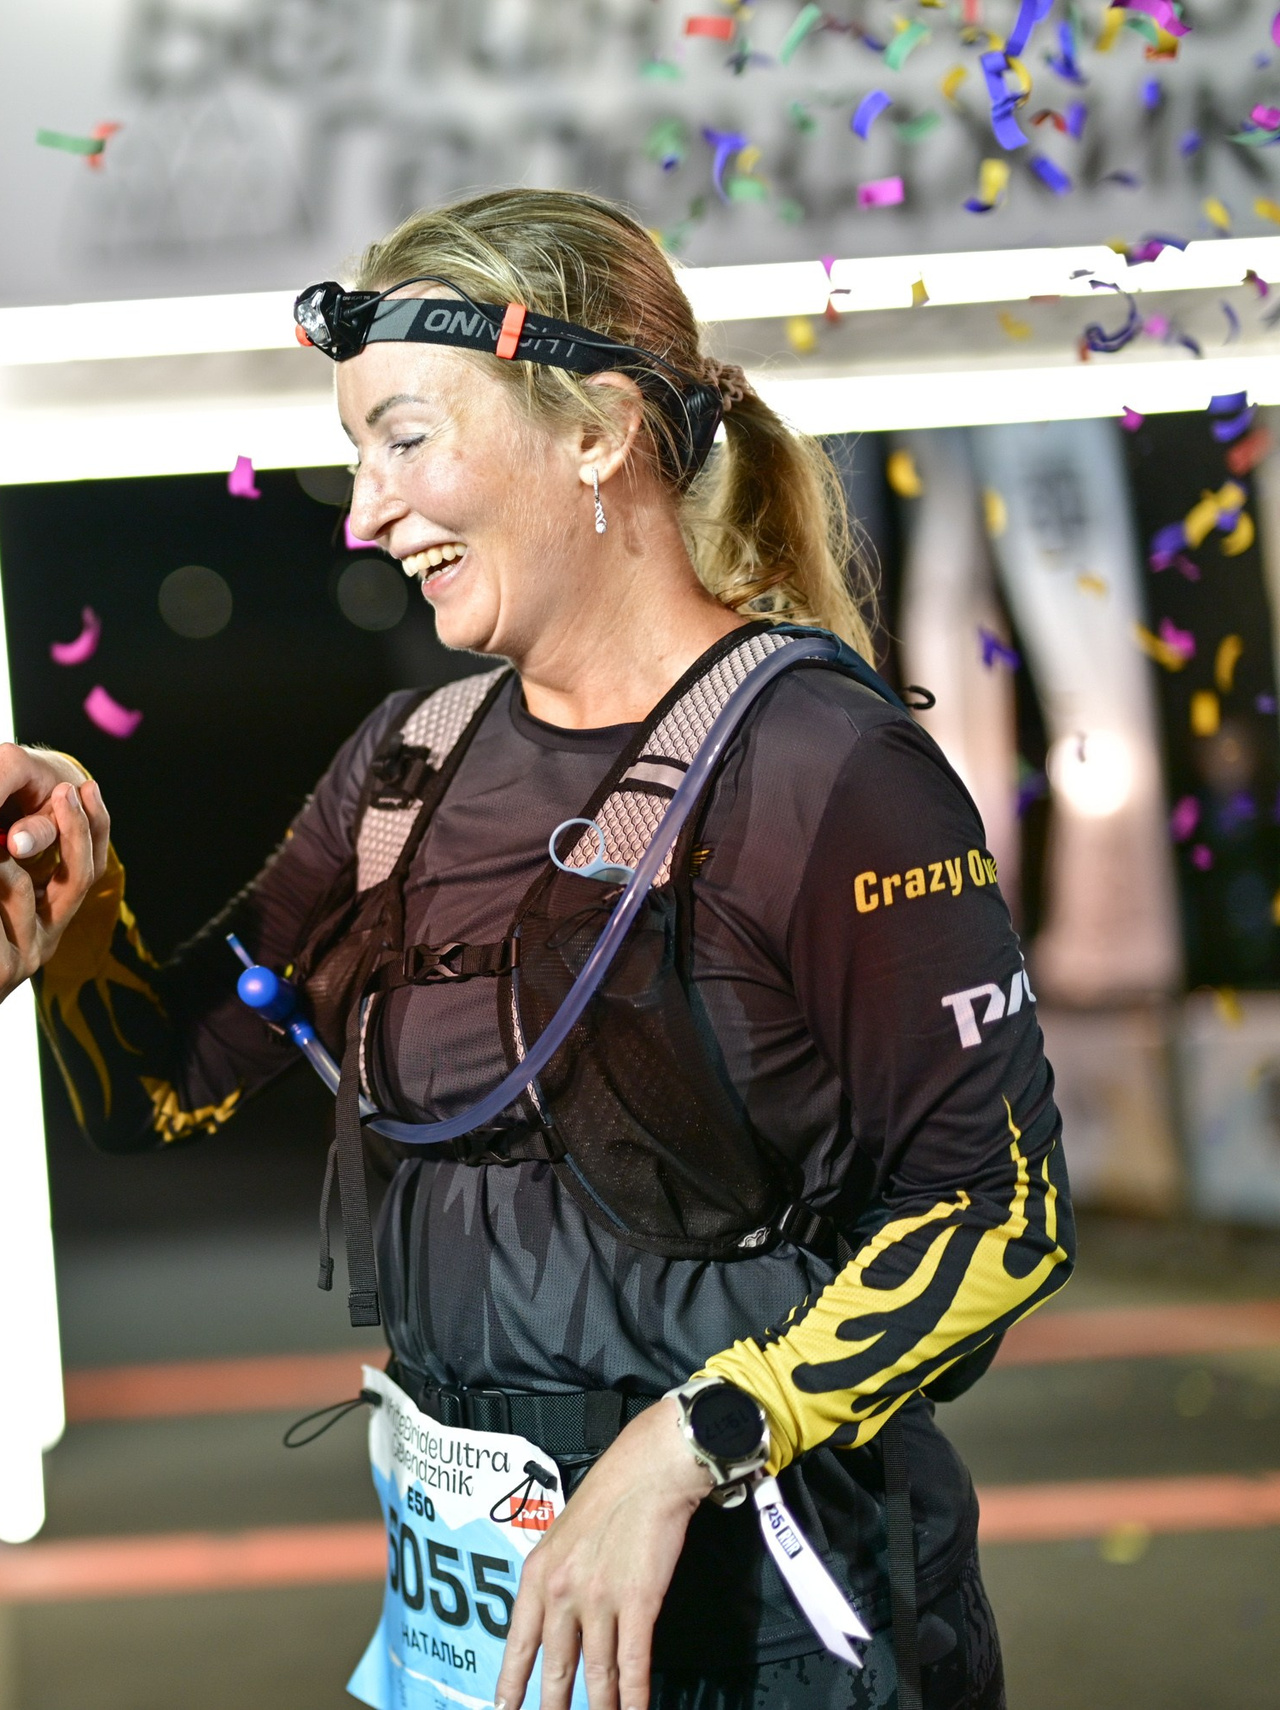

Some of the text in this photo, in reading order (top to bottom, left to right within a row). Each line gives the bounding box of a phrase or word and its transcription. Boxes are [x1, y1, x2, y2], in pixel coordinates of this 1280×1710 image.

[423, 308, 588, 358] ONNGHT
[853, 856, 963, 913] Crazy
[407, 1485, 435, 1522] E50
[401, 1621, 477, 1674] НАТАЛЬЯ
